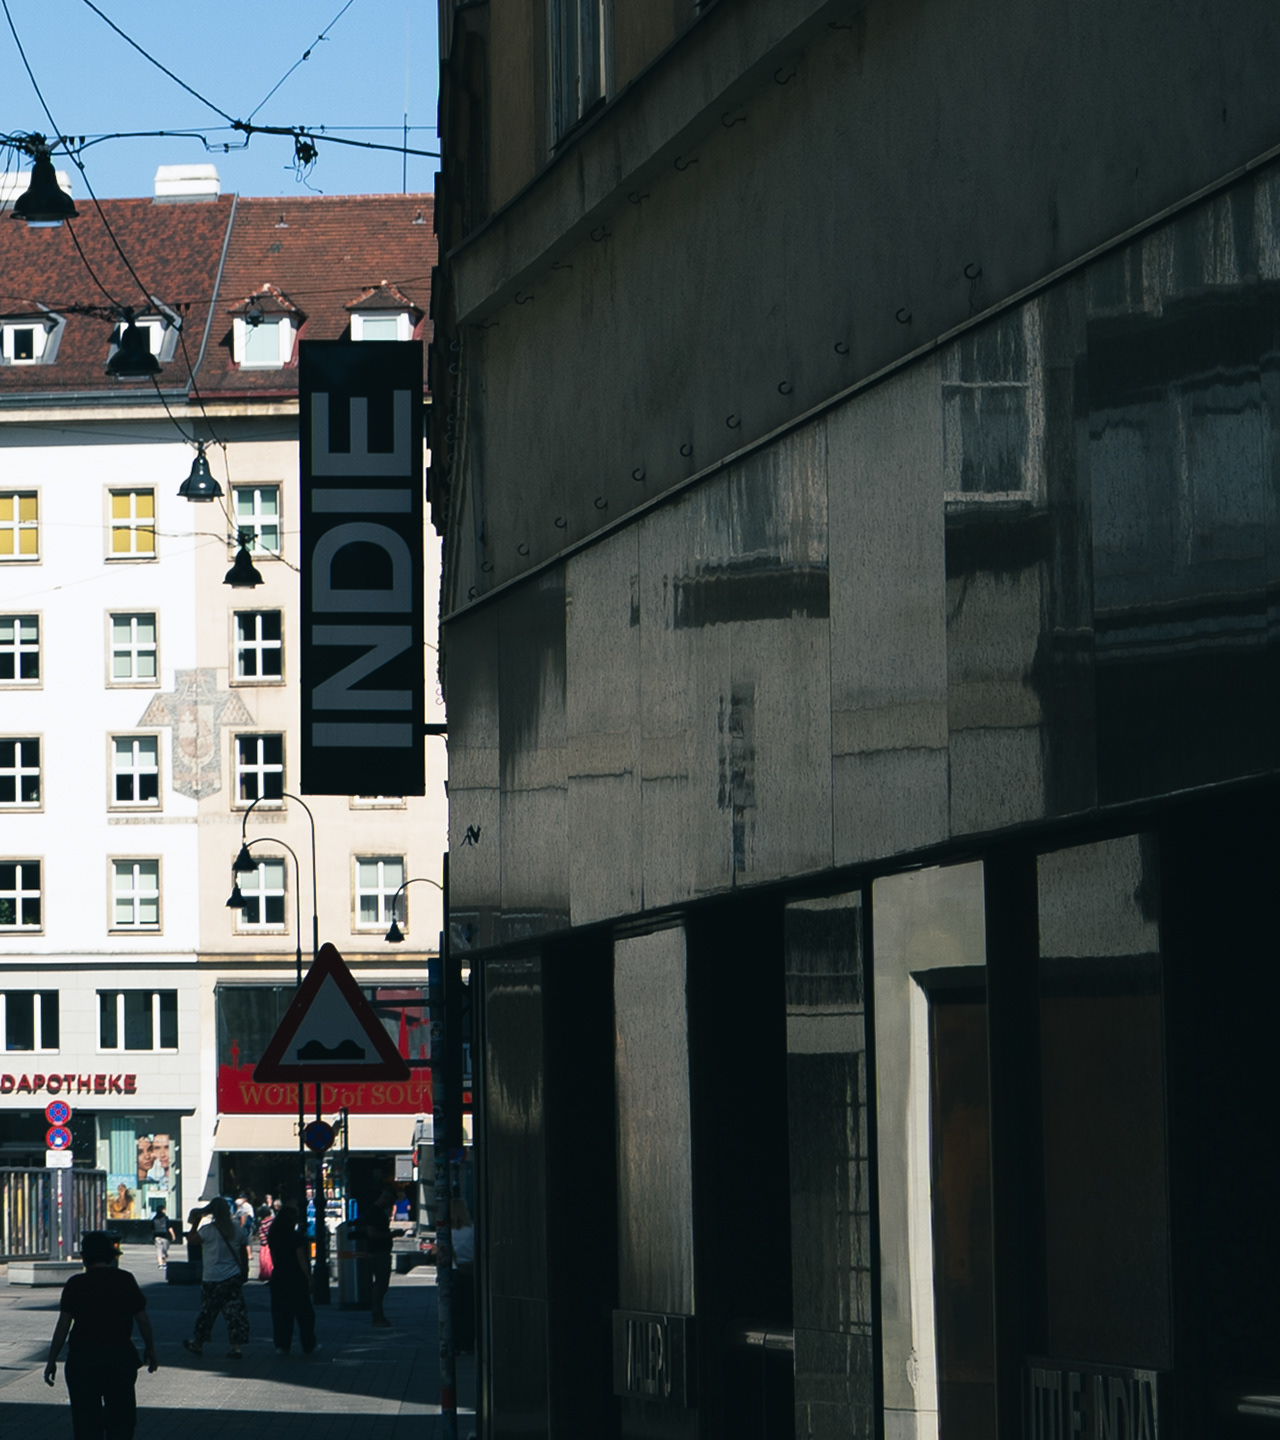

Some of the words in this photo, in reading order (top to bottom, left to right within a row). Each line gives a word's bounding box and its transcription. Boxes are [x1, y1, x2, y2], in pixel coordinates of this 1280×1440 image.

[310, 389, 413, 748] INDIE
[239, 1084, 337, 1105] WORLD
[341, 1084, 366, 1107] of
